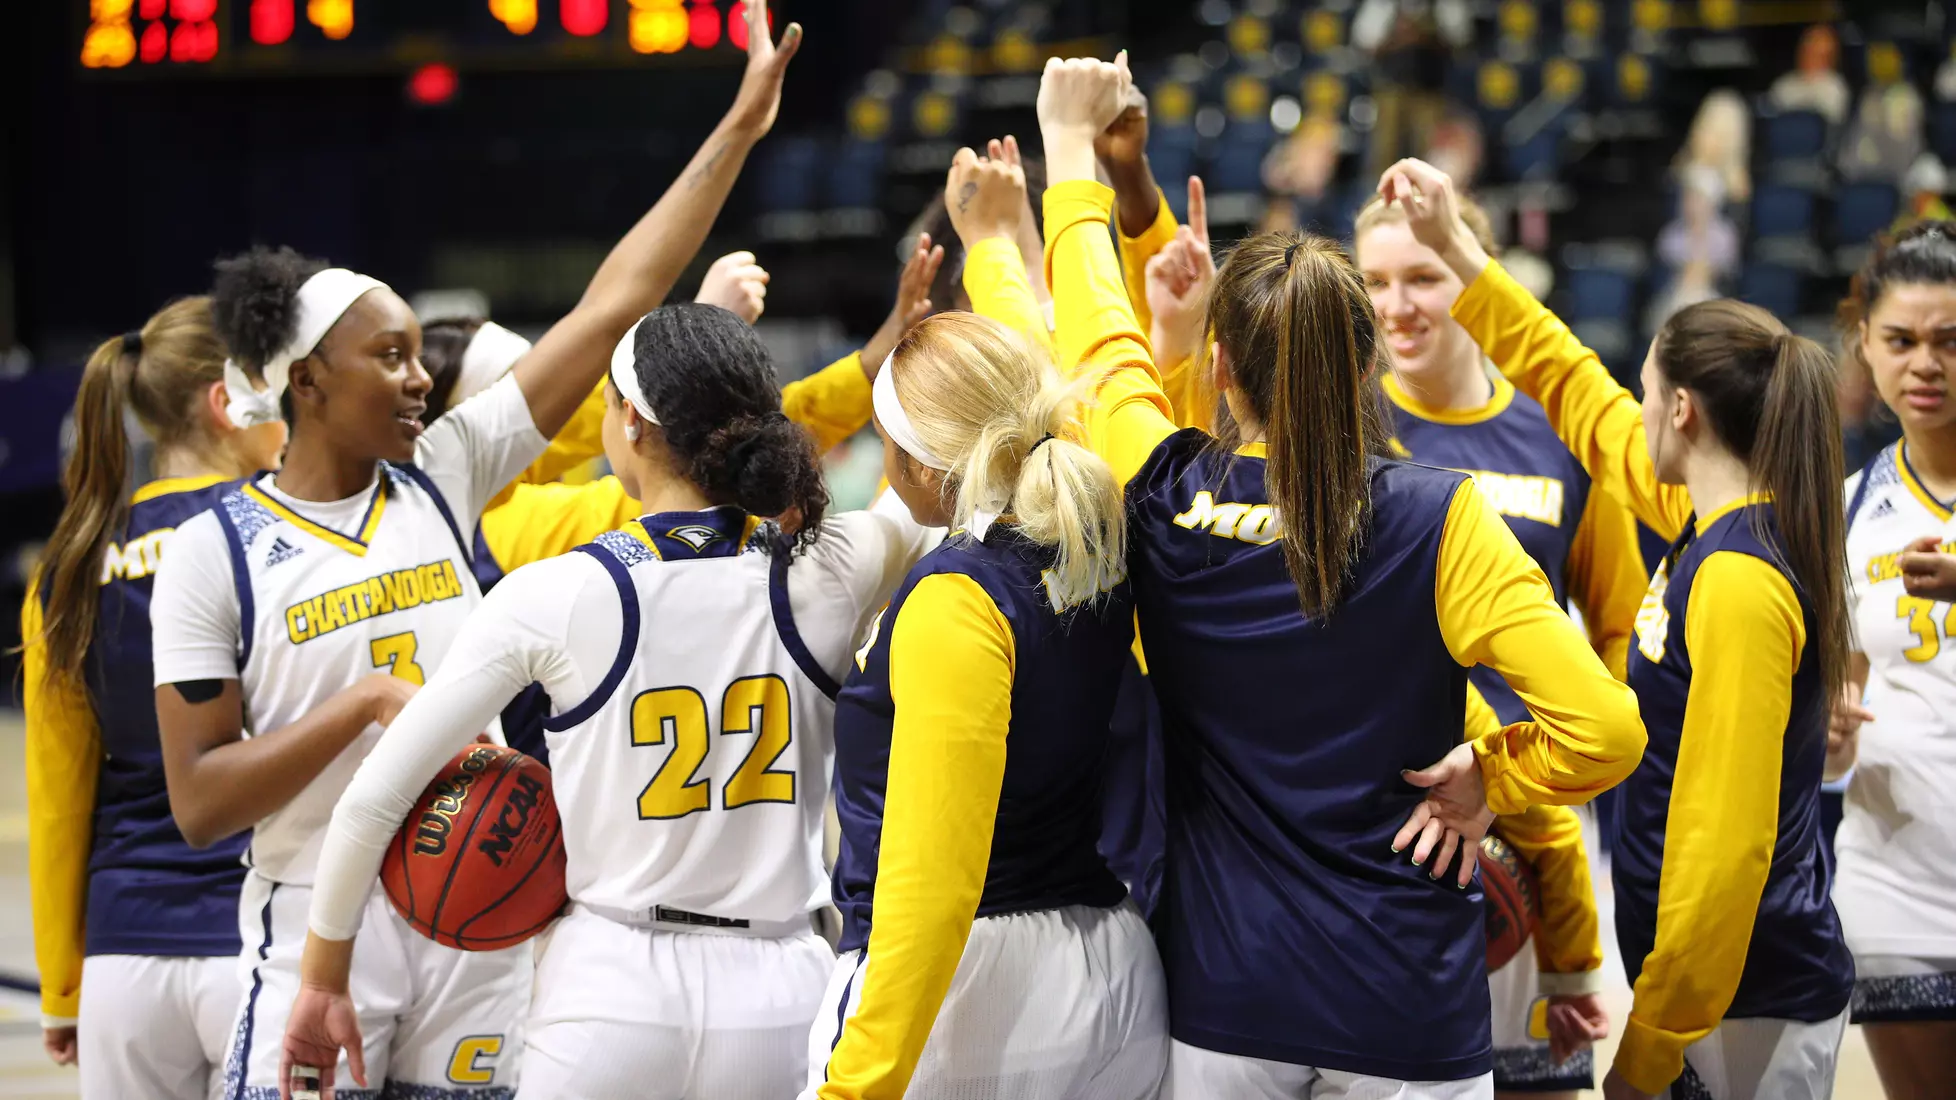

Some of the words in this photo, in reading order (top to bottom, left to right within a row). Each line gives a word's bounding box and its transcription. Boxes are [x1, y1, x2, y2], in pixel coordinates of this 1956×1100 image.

[1173, 490, 1363, 546] MO
[98, 527, 176, 586] MO
[265, 548, 304, 567] adidas
[285, 558, 463, 645] CHATTANOOGA
[630, 673, 796, 820] 22
[413, 747, 505, 858] Wilson
[479, 773, 545, 868] NCAA
[446, 1034, 504, 1085] C
